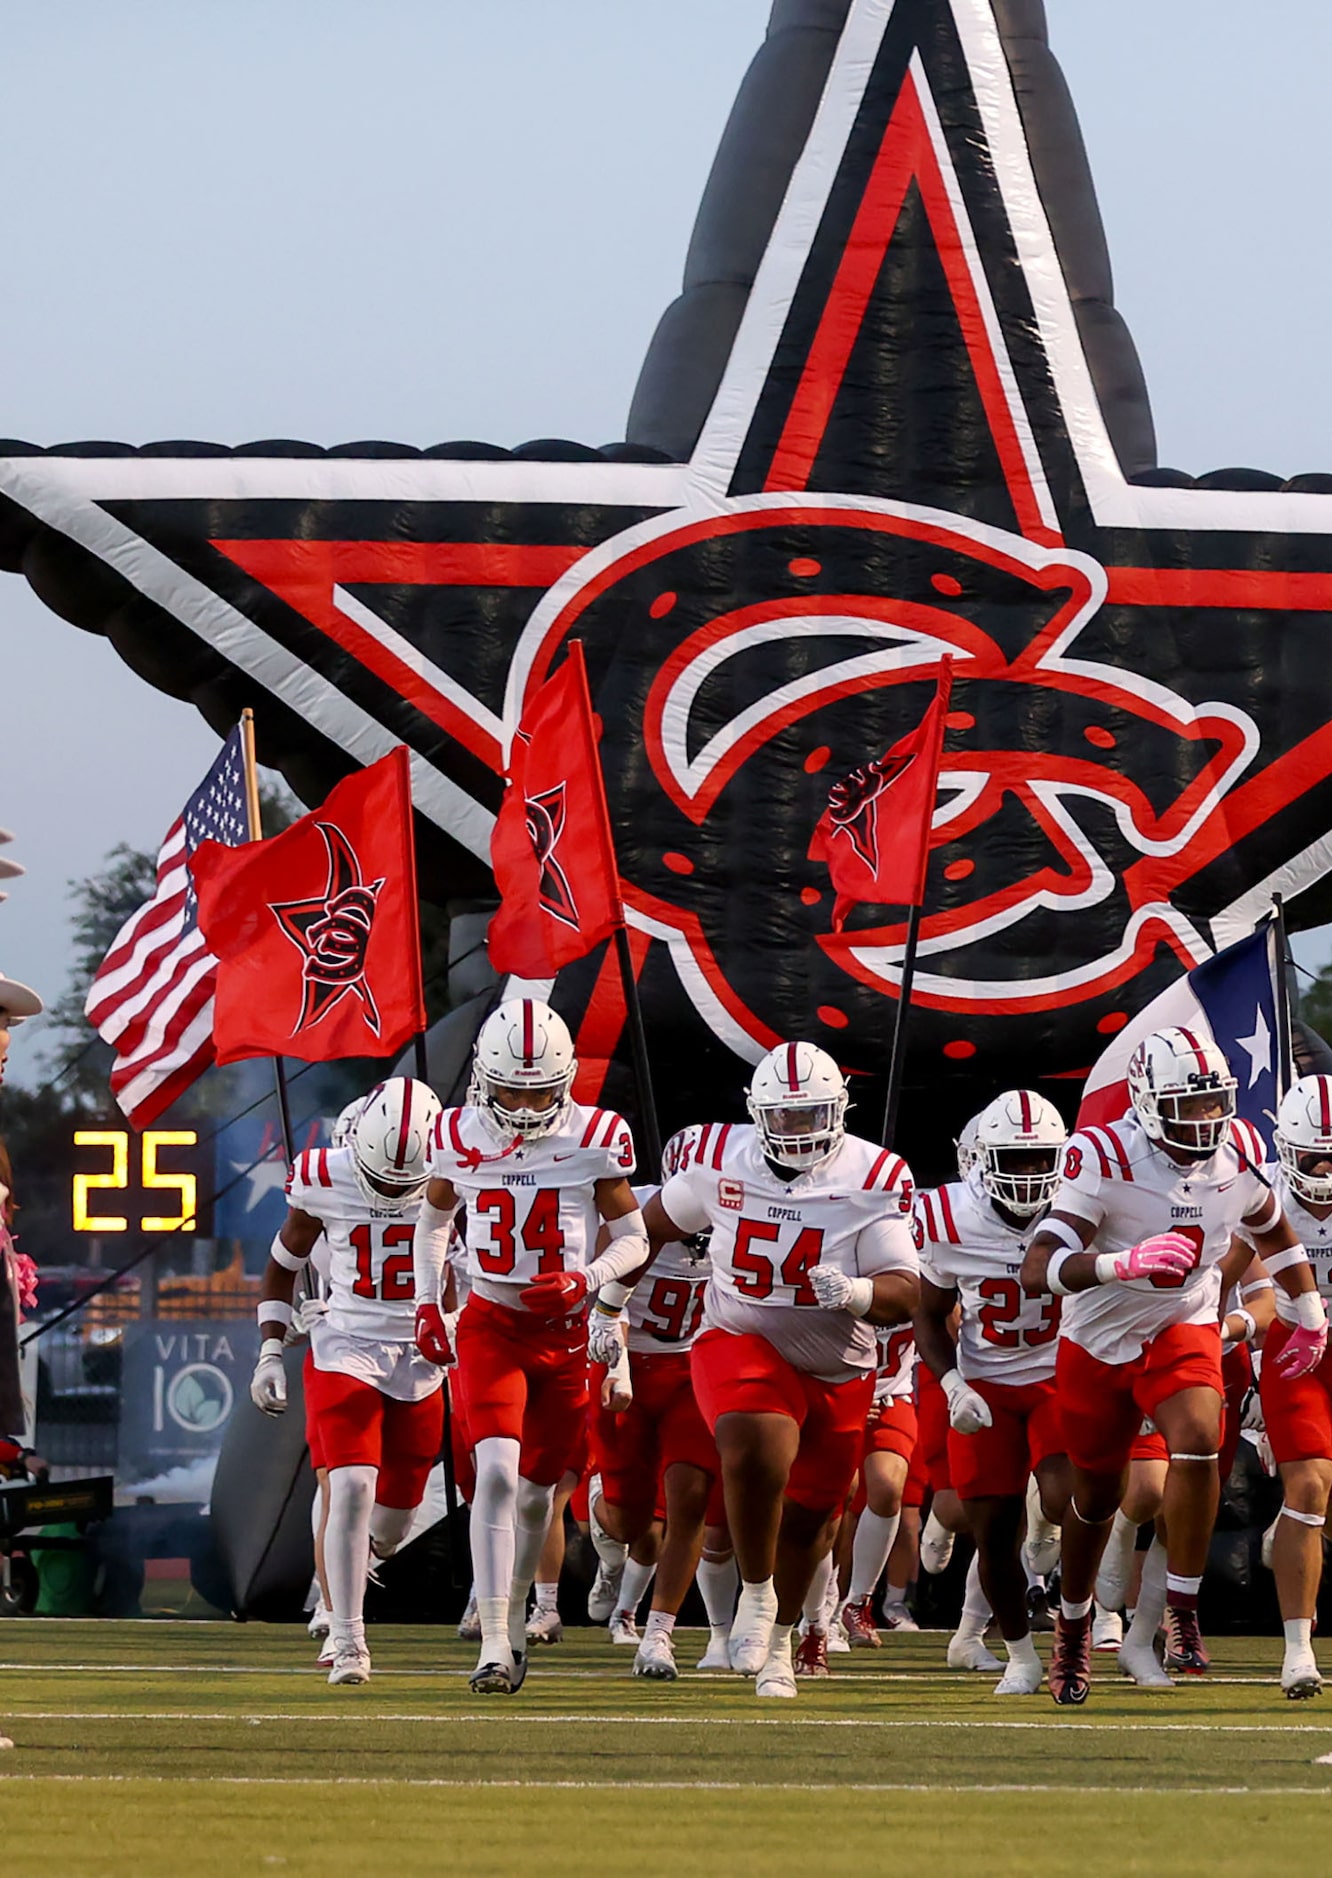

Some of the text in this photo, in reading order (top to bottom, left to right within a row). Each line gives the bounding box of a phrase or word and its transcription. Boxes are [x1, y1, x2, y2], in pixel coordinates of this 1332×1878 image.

[73, 1131, 197, 1231] 25
[501, 1174, 537, 1186] COPPELL
[618, 1132, 634, 1168] 3
[475, 1188, 565, 1275] 34
[767, 1206, 803, 1222] COPPELL
[1170, 1206, 1204, 1218] COPPELL
[349, 1224, 416, 1300] 12
[731, 1216, 825, 1306] 54
[641, 1278, 709, 1343] 91
[979, 1278, 1062, 1347] 23
[154, 1333, 235, 1361] VITA
